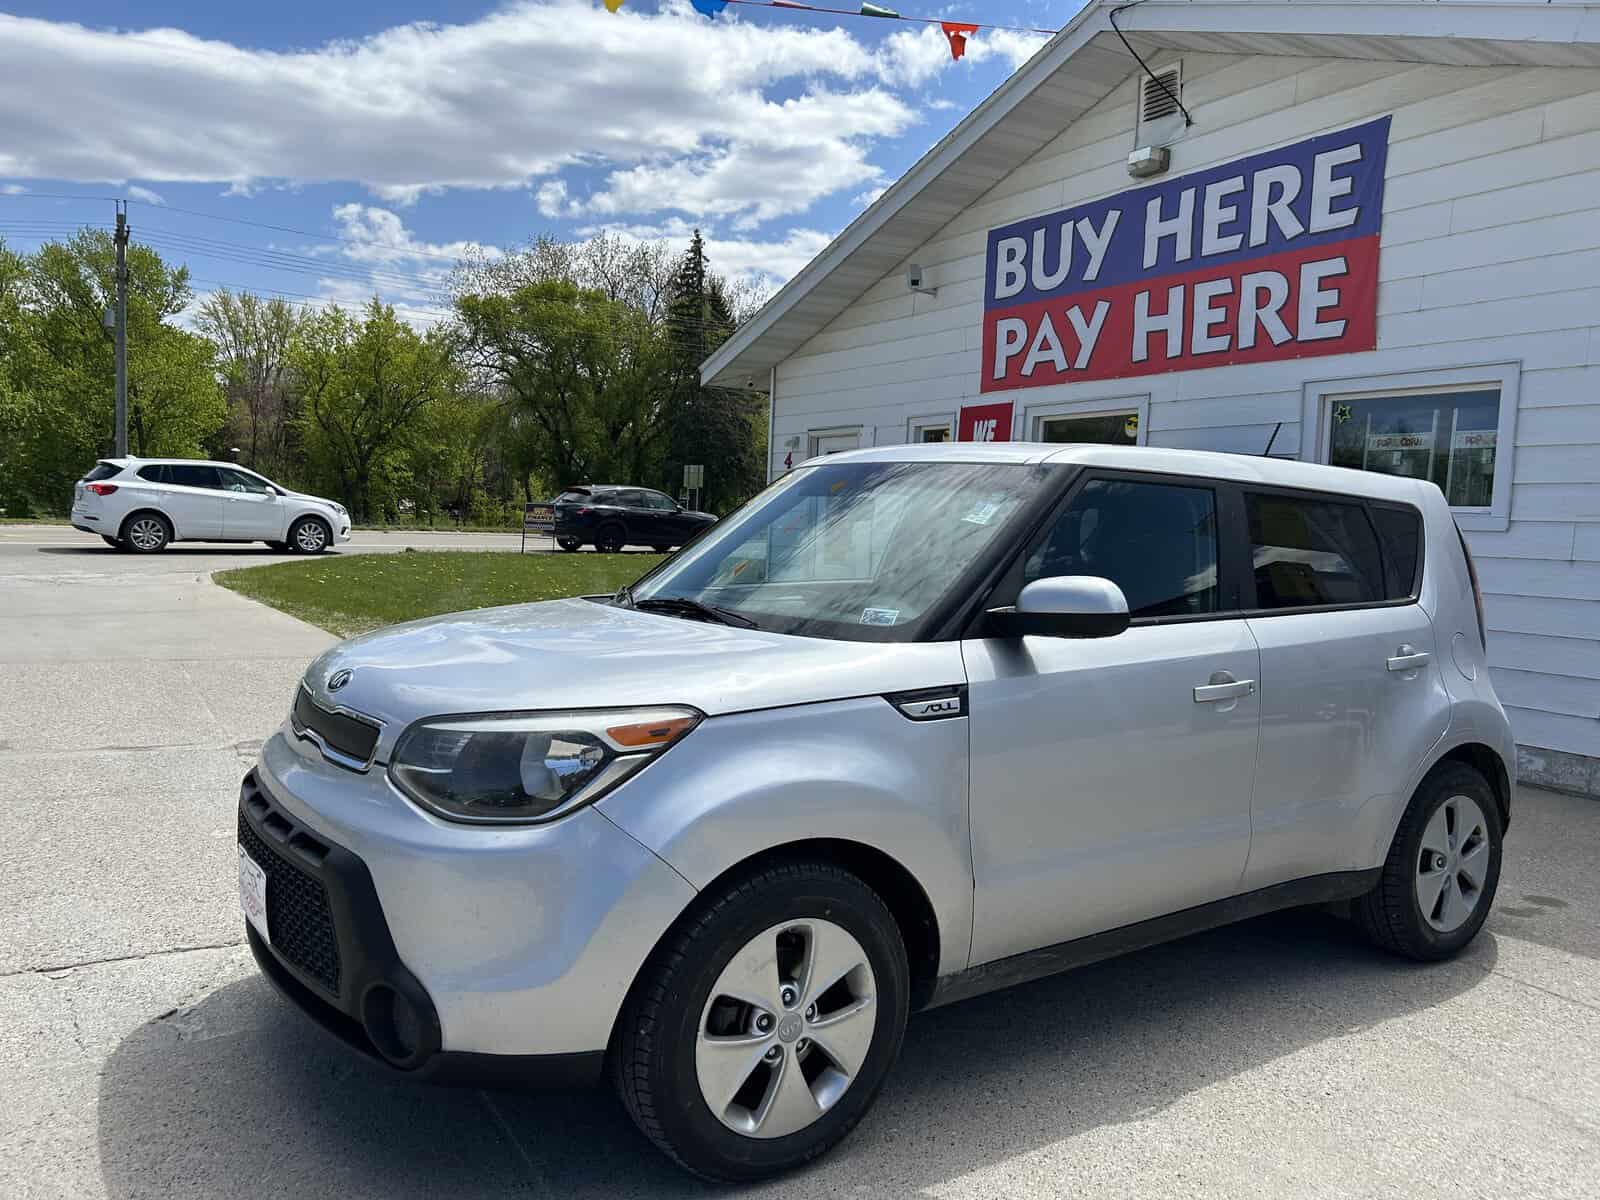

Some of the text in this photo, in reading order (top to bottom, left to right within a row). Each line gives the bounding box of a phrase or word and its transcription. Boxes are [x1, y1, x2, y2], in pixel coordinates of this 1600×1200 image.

[994, 143, 1362, 300] BUY HERE
[992, 256, 1349, 380] PAY HERE
